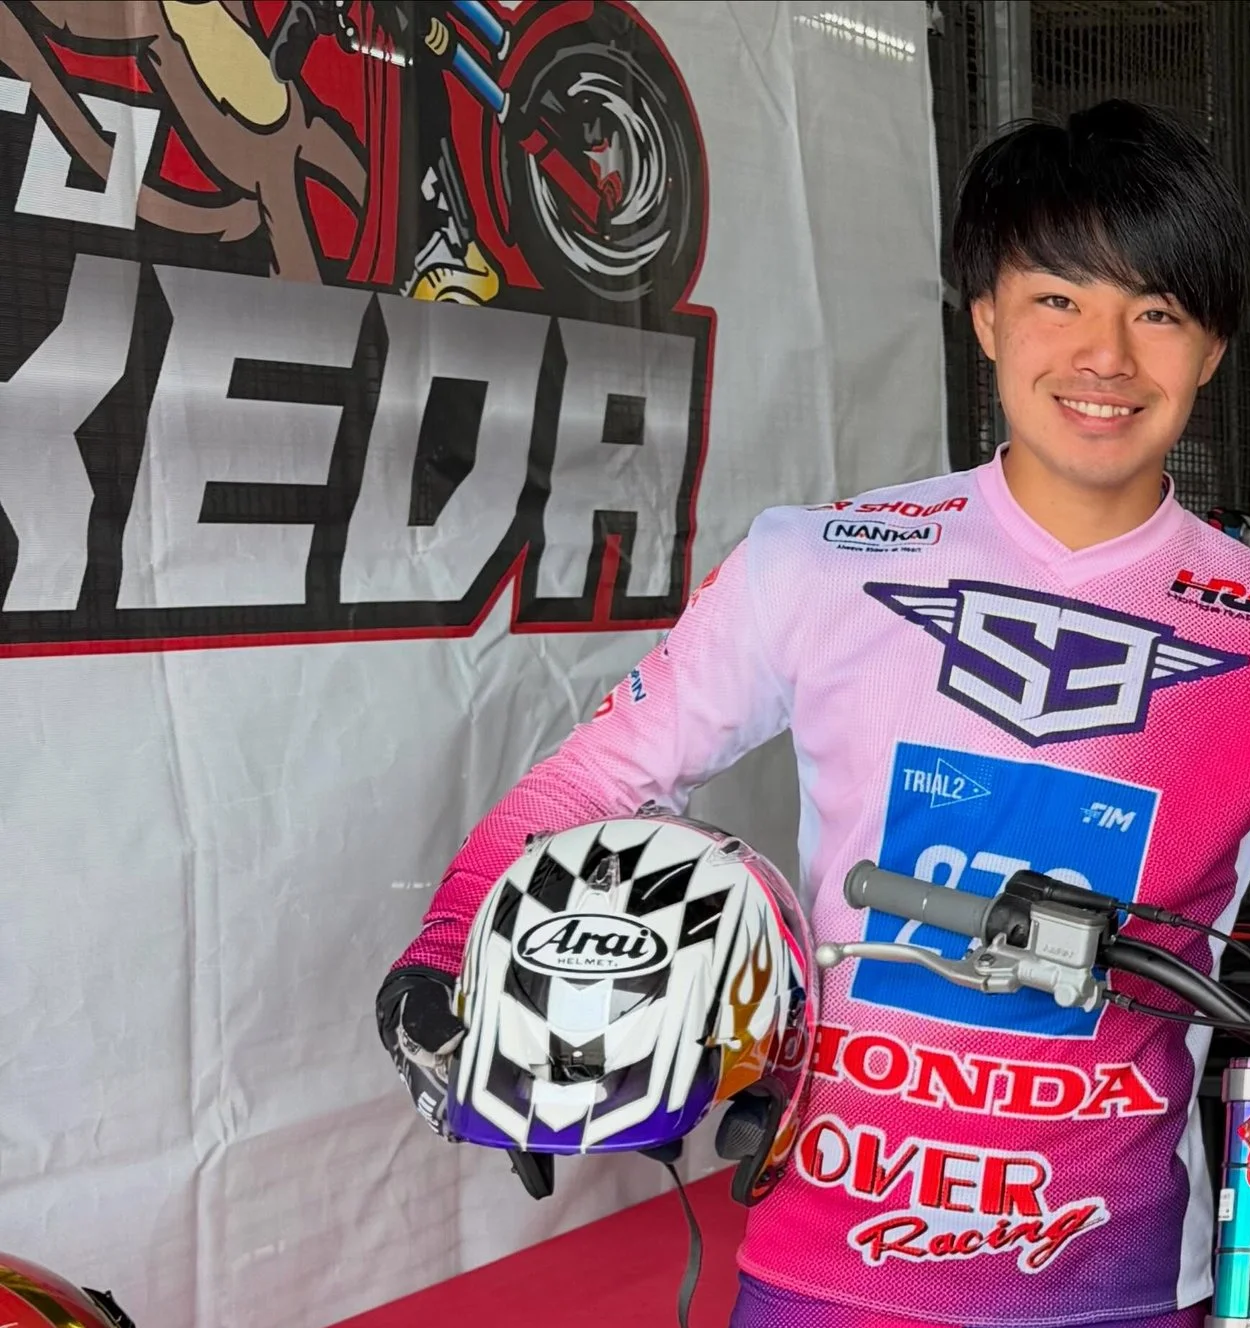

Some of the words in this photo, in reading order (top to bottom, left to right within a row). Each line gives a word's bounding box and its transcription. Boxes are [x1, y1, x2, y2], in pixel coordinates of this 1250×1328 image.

[834, 524, 930, 542] NANKAI
[903, 767, 966, 801] TRIAL2
[1082, 802, 1136, 832] FIM
[522, 918, 652, 958] Arai
[812, 1022, 1168, 1120] HONDA
[799, 1119, 1048, 1219] OVER
[853, 1204, 1105, 1269] Racing
